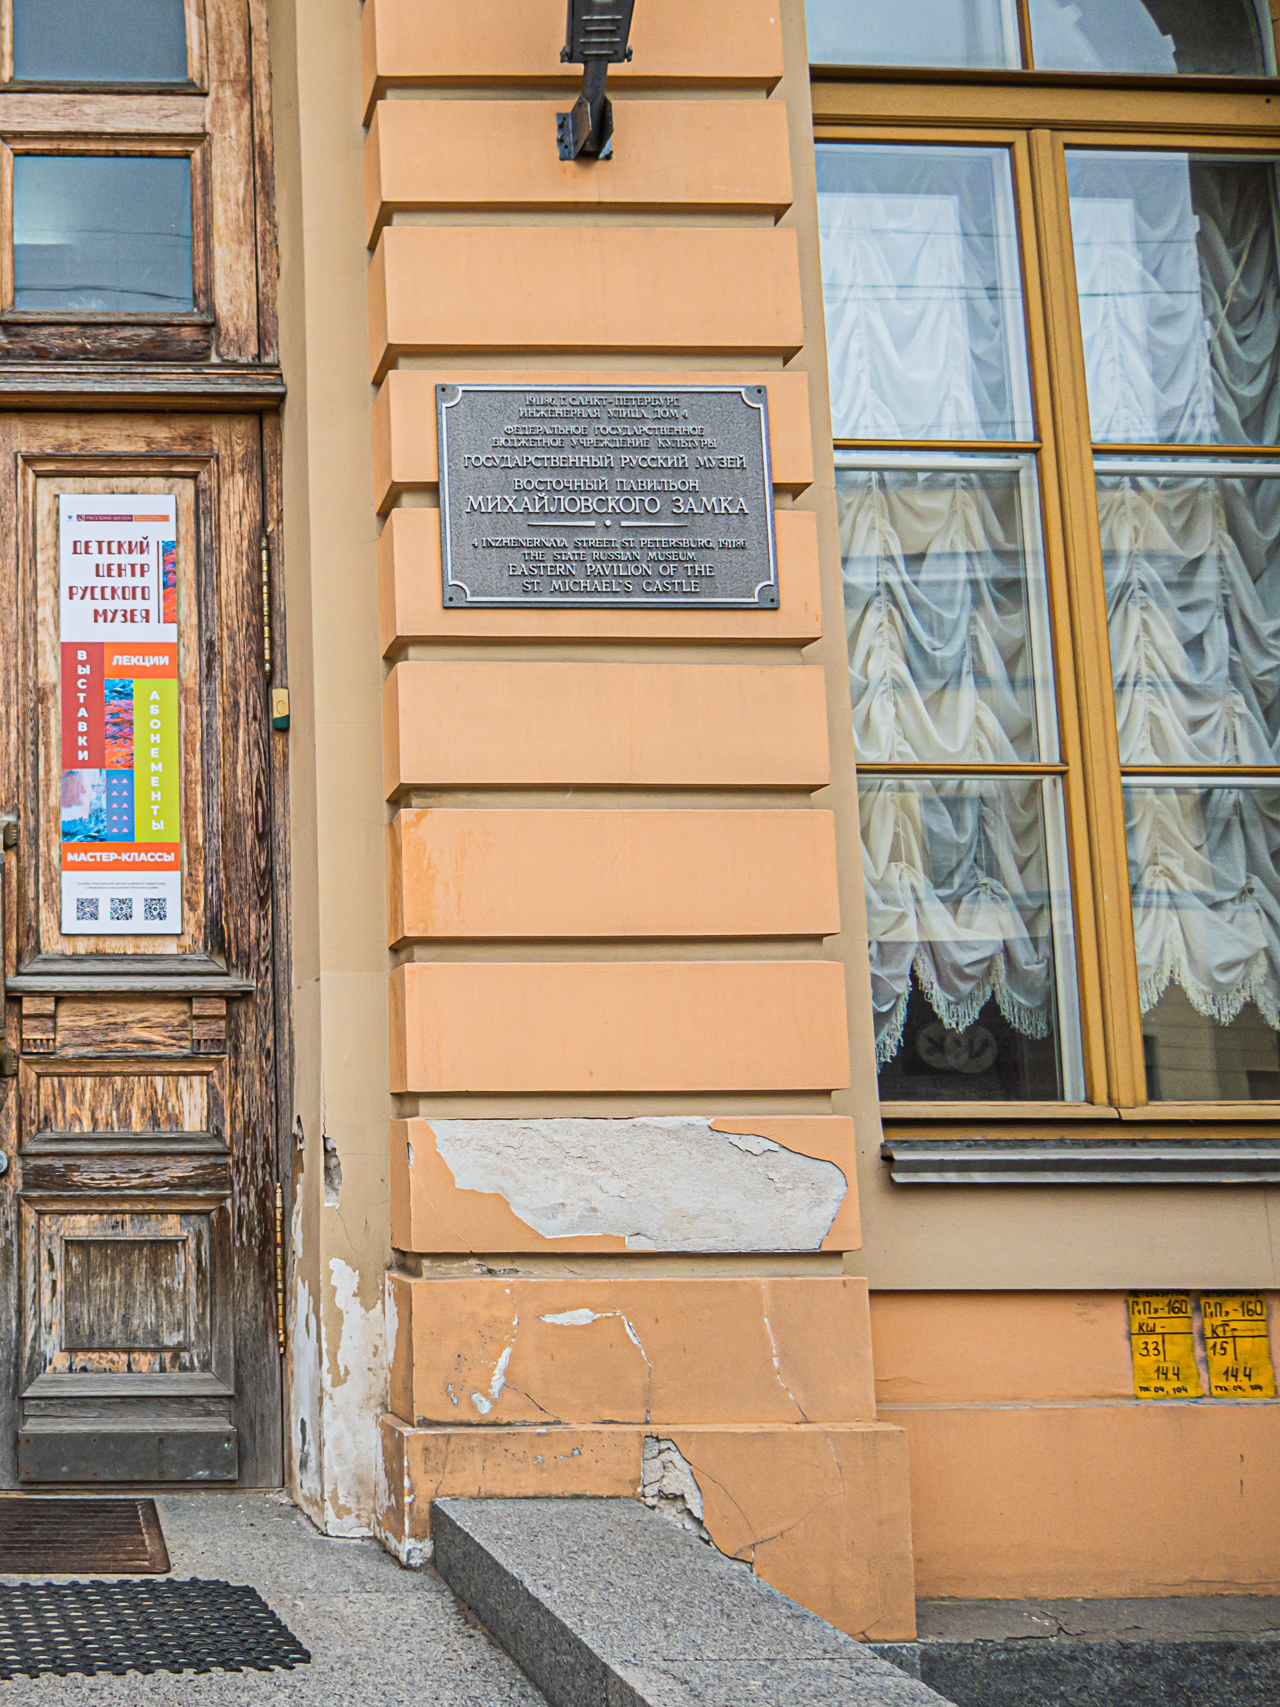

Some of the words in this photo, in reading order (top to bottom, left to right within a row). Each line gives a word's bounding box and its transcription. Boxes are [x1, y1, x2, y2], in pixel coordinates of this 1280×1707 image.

[519, 409, 601, 419] ИНЖЕНЕРНАЯ
[653, 410, 679, 419] ДОМ
[681, 410, 688, 419] 4
[504, 425, 588, 436] ФЕДЕРАЛЬНОЕ
[593, 426, 704, 437] ГОСУДАРСТВЕННОЕ
[492, 438, 565, 448] БЮДЖЕТНОЕ
[570, 438, 650, 449] УЧРЕЖДЕНИЕ
[658, 438, 718, 449] КУЛЬТУРЫ
[463, 454, 615, 470] ГОСУДАРСТВЕННЫЙ
[620, 454, 689, 469] РУССКИЙ
[695, 454, 747, 469] МУЗЕЙ
[513, 477, 608, 492] ВОСТОЧНЫЙ
[615, 479, 700, 492] ПАВИЛЬОН
[465, 493, 661, 514] МИХАЙЛОВСКОГО
[672, 496, 749, 515] ЗАМКА
[72, 536, 150, 555] ДЕТСКИЙ
[472, 538, 478, 548] 4
[482, 538, 568, 548] INZHENERNAYA
[621, 538, 637, 549] ST.
[639, 539, 715, 549] PETERSBURG,
[523, 552, 546, 561] THE
[553, 552, 587, 561] STATE
[592, 552, 640, 561] RUSSIAN
[647, 552, 697, 561] MUSEUM
[95, 563, 150, 577] ЦЕНТР
[508, 564, 576, 576] EASTERN
[585, 564, 653, 577] PAVILION
[659, 565, 678, 576] OF
[684, 565, 715, 576] THE
[68, 586, 150, 600] РУССКОГО
[522, 580, 543, 592] ST.
[550, 580, 633, 593] MICHAEL'S
[643, 580, 700, 593] CASTLE
[93, 609, 150, 623] МУЗЕЯ
[112, 655, 169, 667] ЛЕКЦИИ
[76, 650, 91, 760] ВЫСТАВКИ
[149, 690, 164, 830] АБОНЕМЕНТЫ
[67, 852, 174, 862] МАСТЕР-КЛАССЫ
